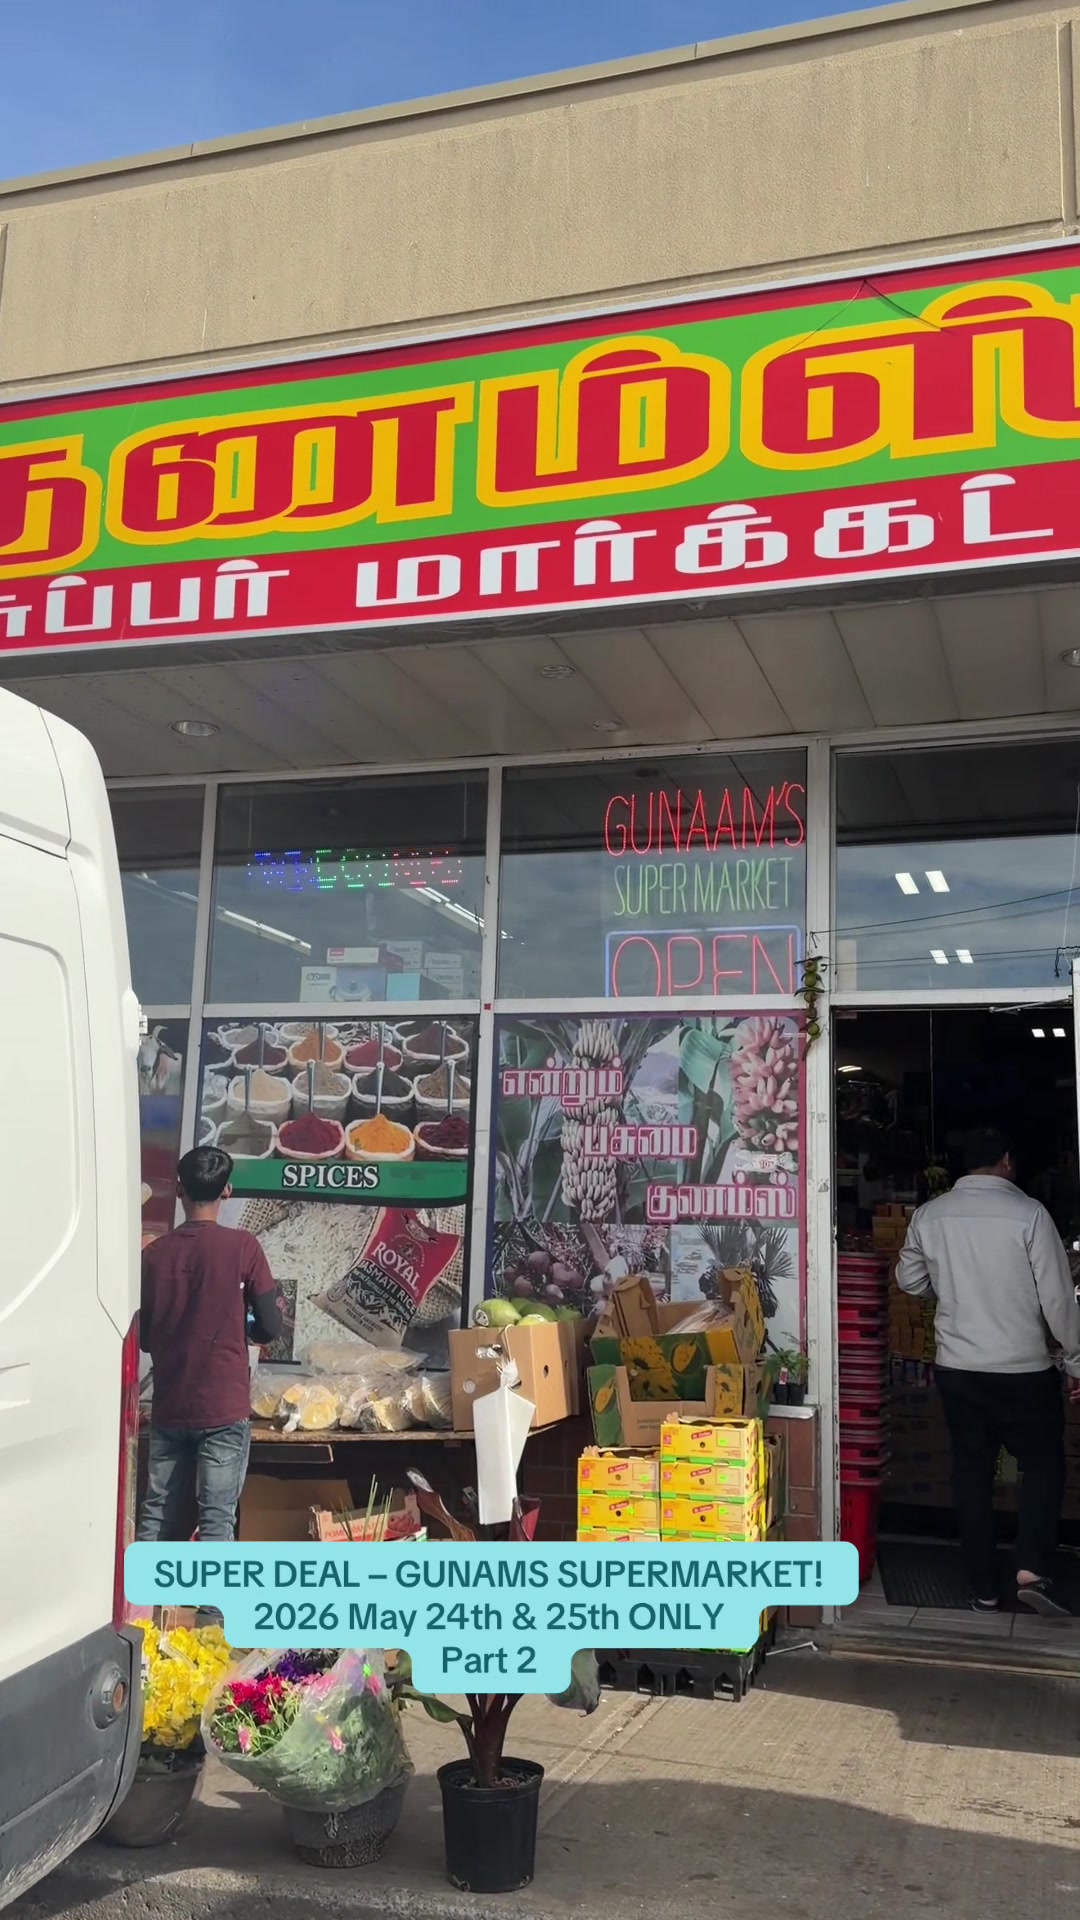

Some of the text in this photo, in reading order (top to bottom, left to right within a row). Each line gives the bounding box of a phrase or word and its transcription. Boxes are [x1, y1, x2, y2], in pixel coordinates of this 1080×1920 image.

[356, 474, 1053, 607] மார்க்கட்
[605, 782, 804, 856] GUNAAM'S
[614, 857, 794, 916] SUPER MARKET
[612, 934, 793, 997] OPEN
[503, 1057, 622, 1105] என்றும்
[282, 1163, 379, 1188] SPICES
[371, 1241, 420, 1290] ROYAL
[397, 1290, 416, 1315] RICE
